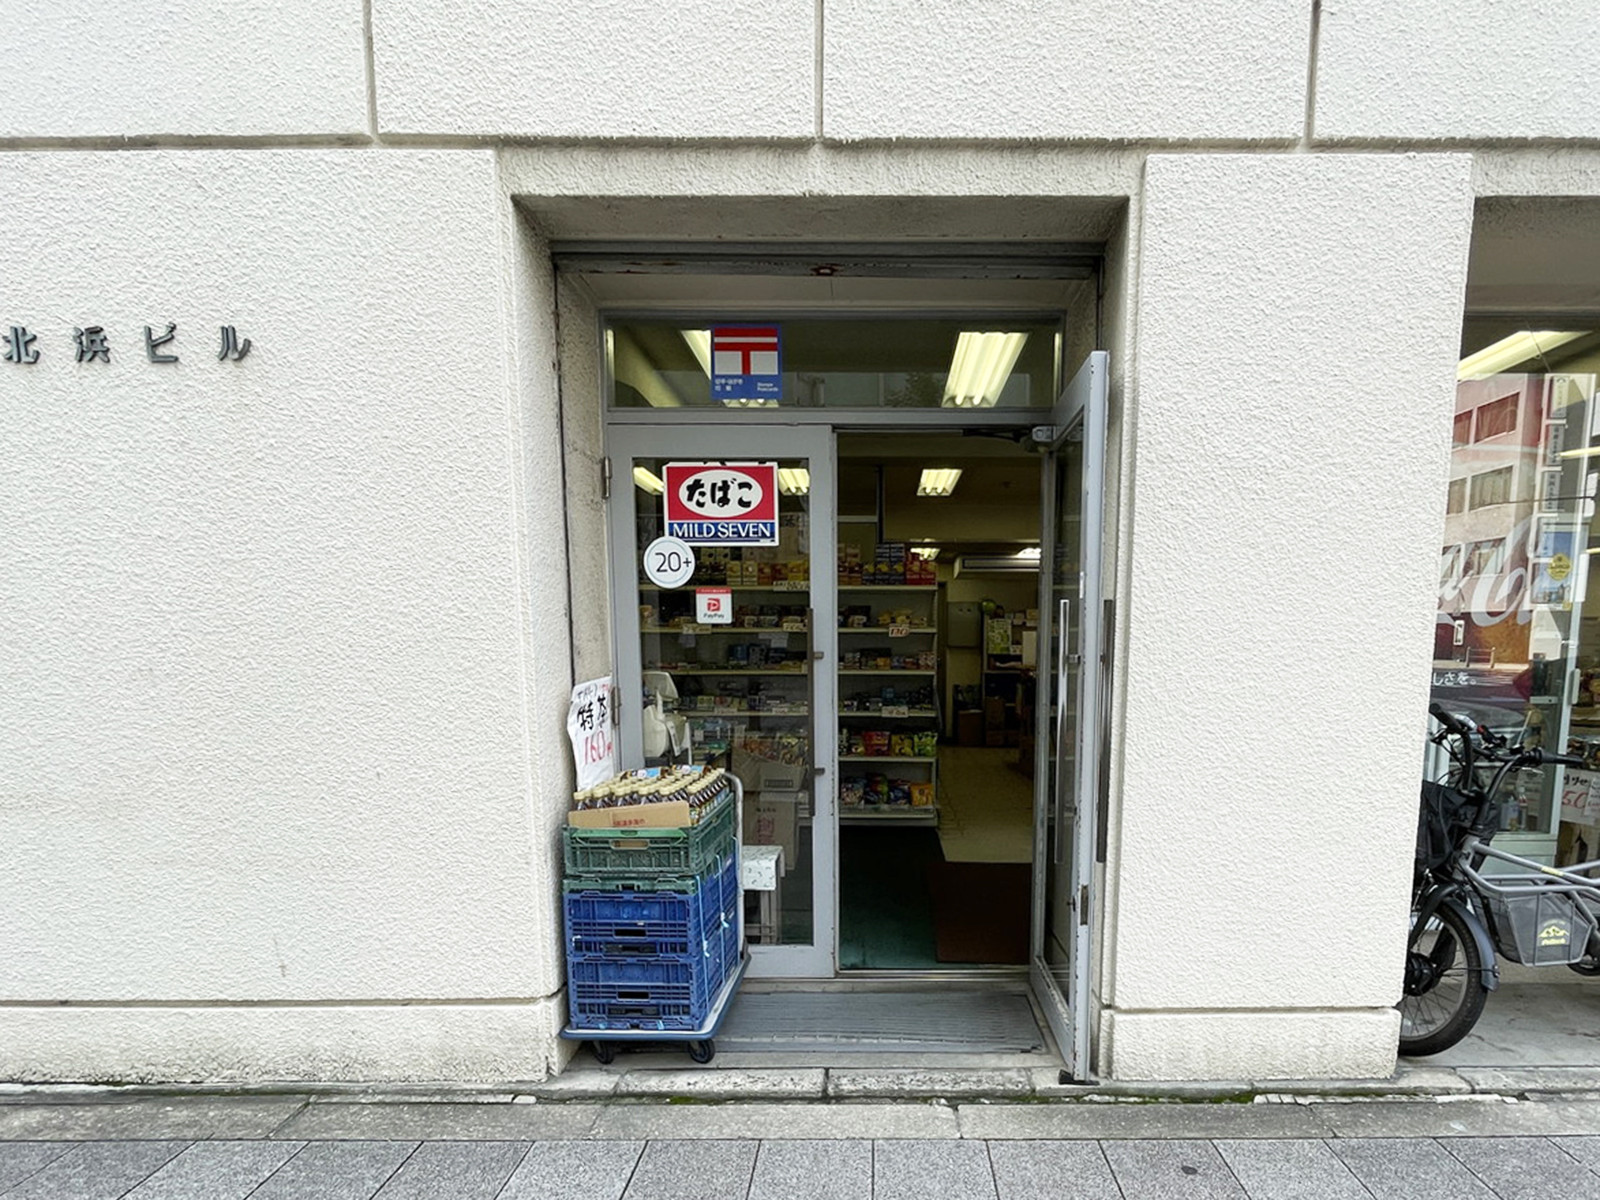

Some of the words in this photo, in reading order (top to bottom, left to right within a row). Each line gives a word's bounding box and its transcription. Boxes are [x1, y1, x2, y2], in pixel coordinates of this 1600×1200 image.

[2, 321, 252, 364] 北浜ビル
[685, 477, 753, 508] たばこ
[672, 523, 716, 538] MILD
[717, 521, 771, 538] SEVEN
[654, 551, 692, 573] 20+
